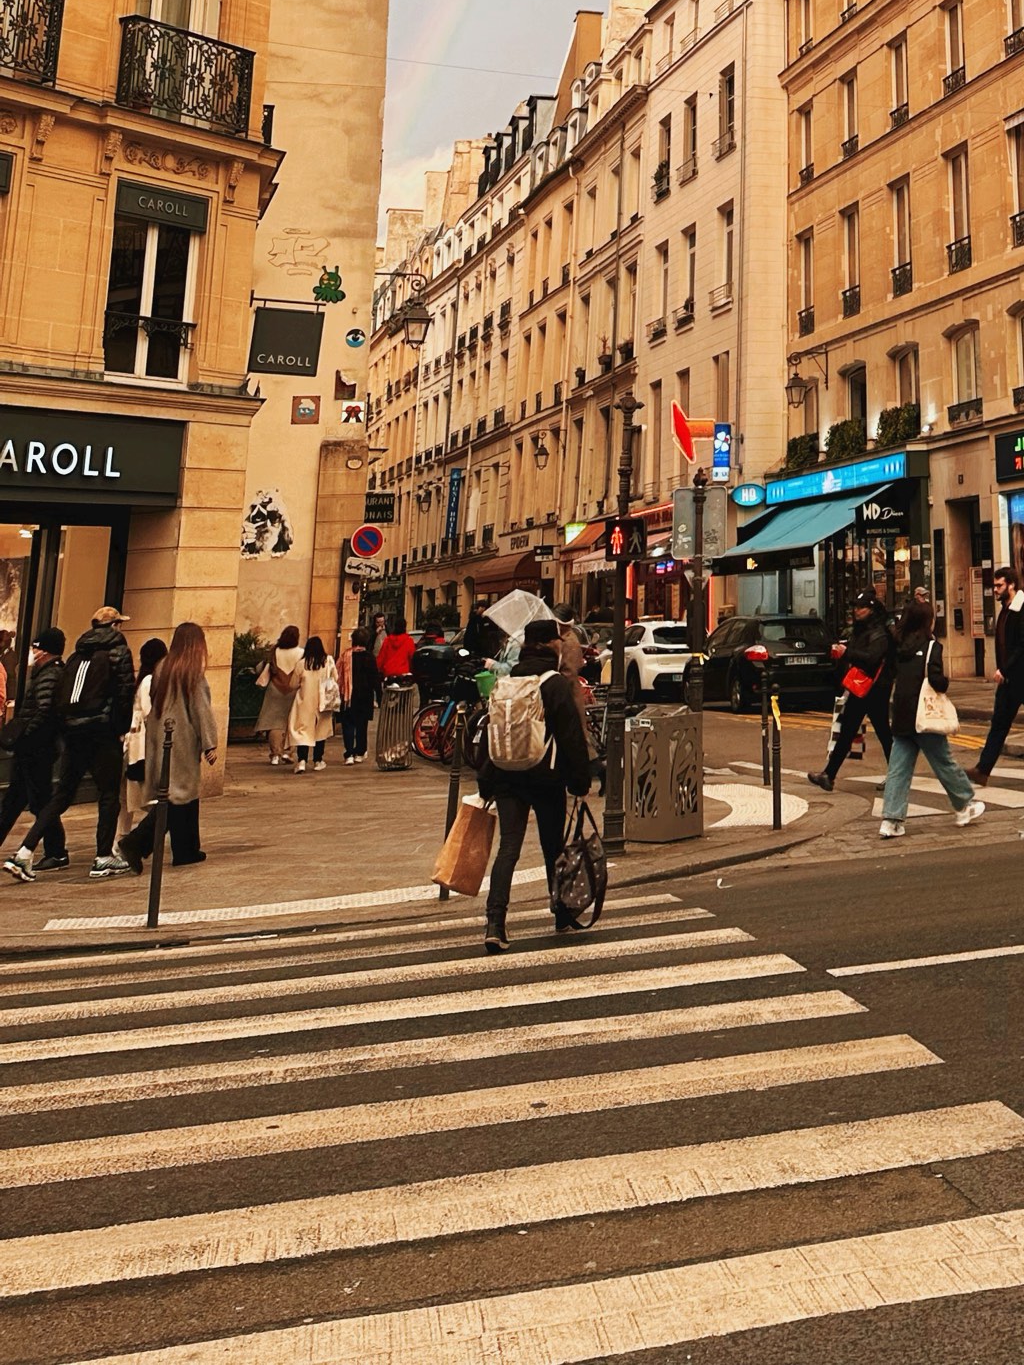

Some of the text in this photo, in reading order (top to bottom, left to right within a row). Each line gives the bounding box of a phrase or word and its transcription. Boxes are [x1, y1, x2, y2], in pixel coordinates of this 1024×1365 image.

[138, 196, 188, 217] CAROLL
[257, 354, 311, 367] CAROLL
[0, 440, 120, 477] AROLL
